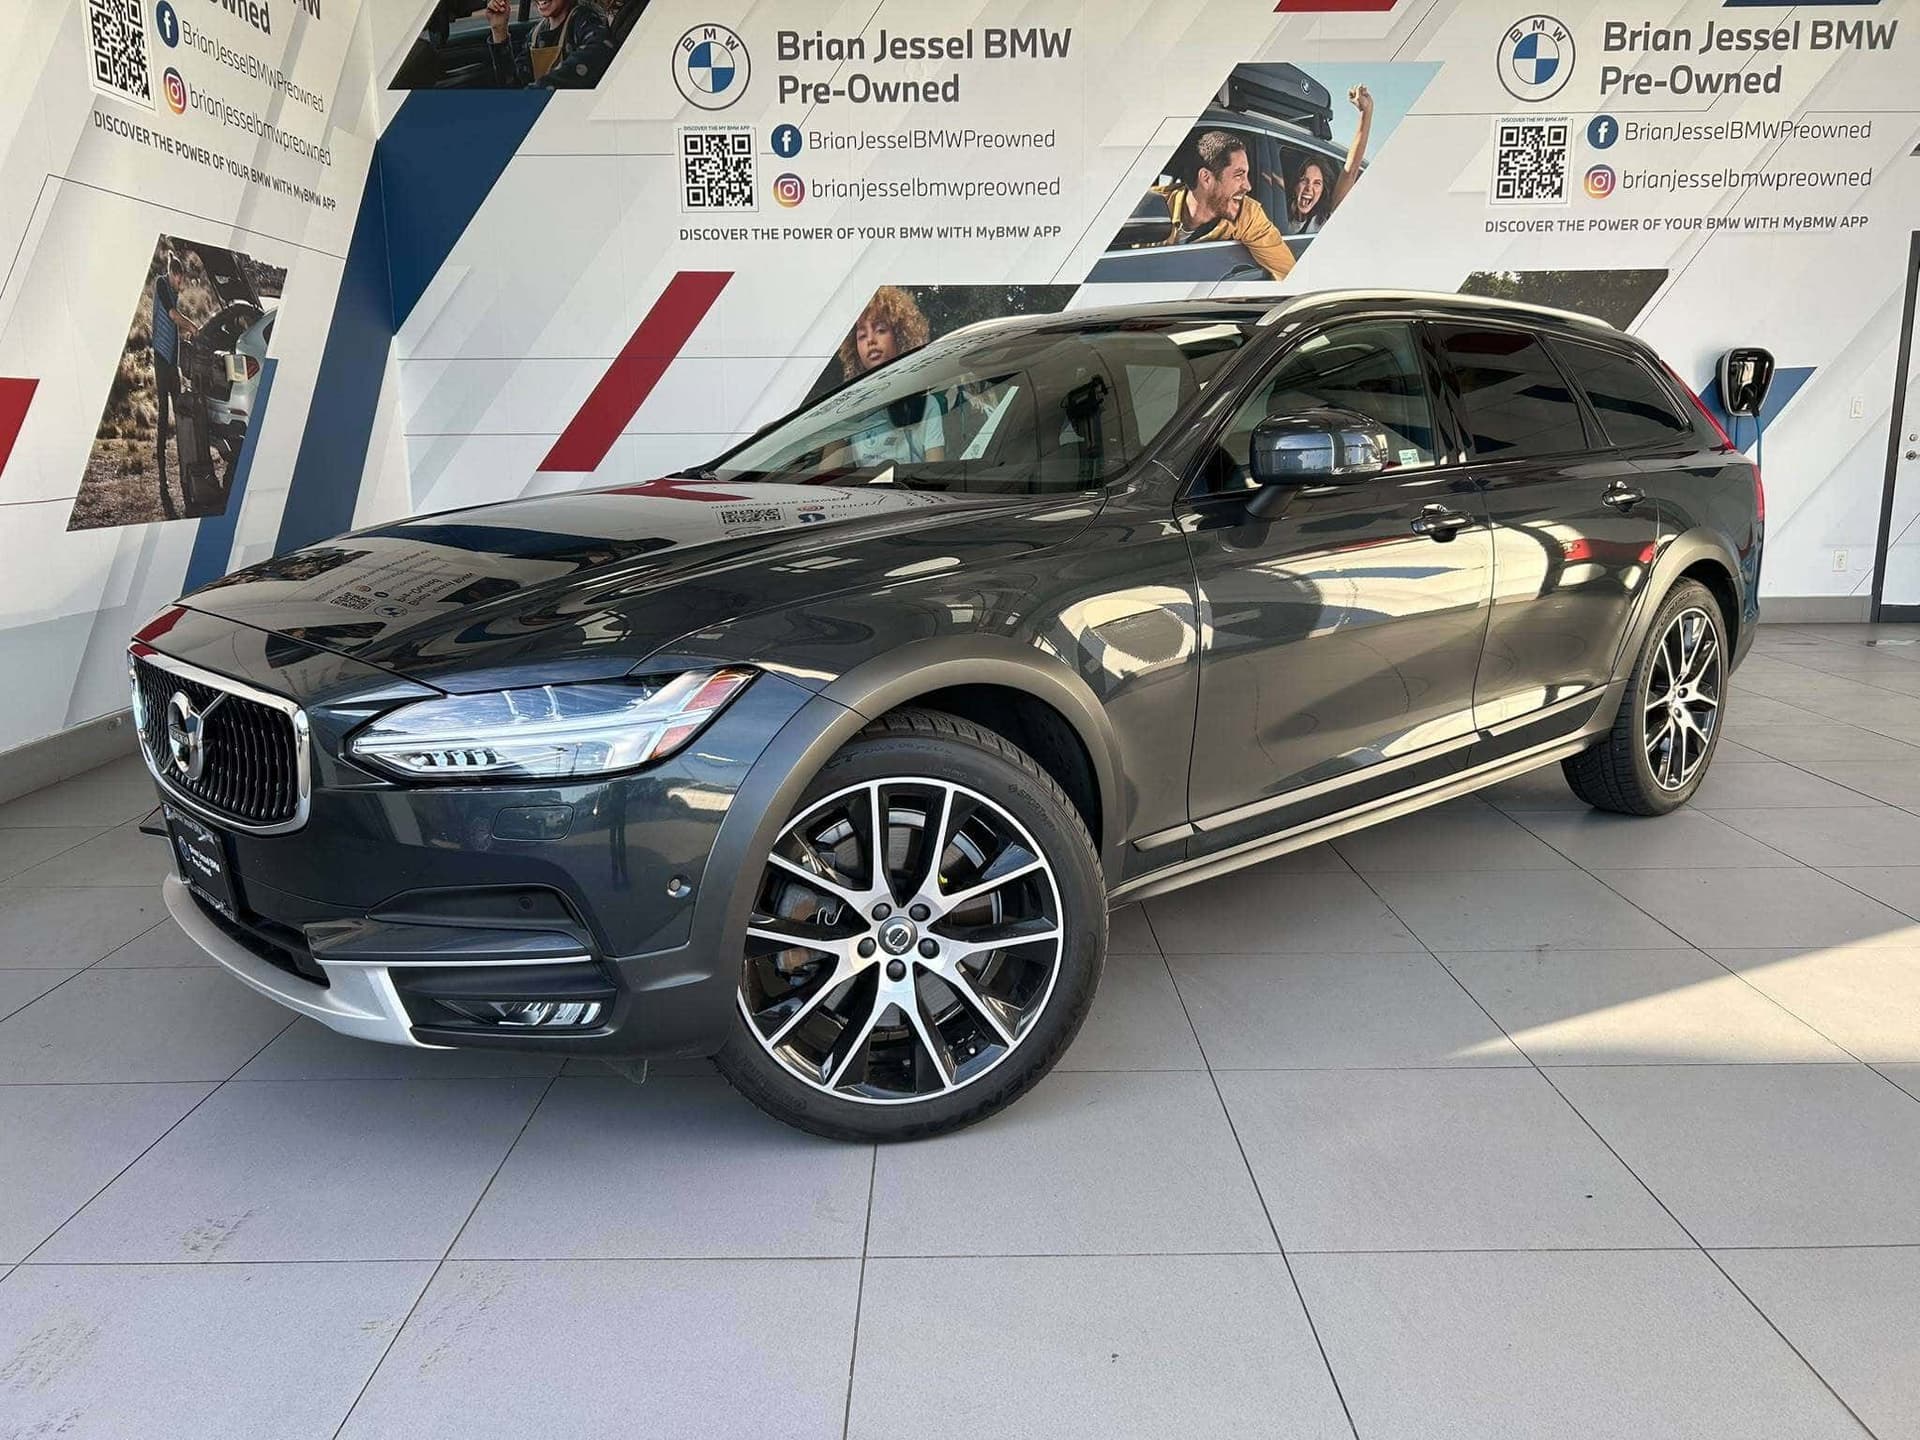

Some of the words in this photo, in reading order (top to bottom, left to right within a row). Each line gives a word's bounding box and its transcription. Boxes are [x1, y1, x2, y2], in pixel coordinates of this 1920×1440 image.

[777, 30, 866, 61] Brian
[873, 30, 973, 63] Jessel
[984, 27, 1073, 59] BMW
[1603, 20, 1691, 53] Brian
[1698, 20, 1800, 55] Jessel
[1810, 19, 1899, 51] BMW
[182, 20, 324, 113] BrianJesselBMWPreowned
[1600, 65, 1782, 96] Pre-Owned
[778, 73, 960, 105] Pre-Owned
[190, 83, 331, 166] brianjesselbmwpreowned
[809, 129, 1056, 151] BrianJesselBMWPreowned
[1625, 121, 1873, 143] BrianJesselBMWPreowned
[94, 110, 151, 146] DISCOVER
[152, 132, 174, 154] THE
[175, 141, 211, 166] POWER
[213, 154, 225, 170] OF
[226, 158, 251, 181] YOUR
[251, 169, 271, 188] BMW
[272, 176, 292, 196] WITH
[293, 184, 321, 206] MyBMW
[321, 195, 336, 212] APP
[811, 177, 1061, 202] brianjesselbmwpreowned
[1622, 168, 1873, 193] brianjesselbmwpreowned
[679, 227, 749, 241] DISCOVER
[750, 227, 780, 241] THE
[783, 227, 833, 240] POWER
[836, 227, 856, 240] OF
[858, 227, 896, 239] YOUR
[899, 226, 934, 239] BMW
[937, 226, 972, 239] WITH
[976, 225, 1030, 241] MyBMW
[1033, 225, 1062, 238] APP
[1485, 219, 1554, 233] DISCOVER
[1557, 219, 1585, 232] THE
[1589, 218, 1639, 232] POWER
[1643, 218, 1662, 231] OF
[1664, 218, 1703, 231] YOUR
[1706, 217, 1741, 230] BMW
[1744, 217, 1780, 230] WITH
[1782, 216, 1837, 232] MyBMW
[1840, 215, 1869, 229] APP
